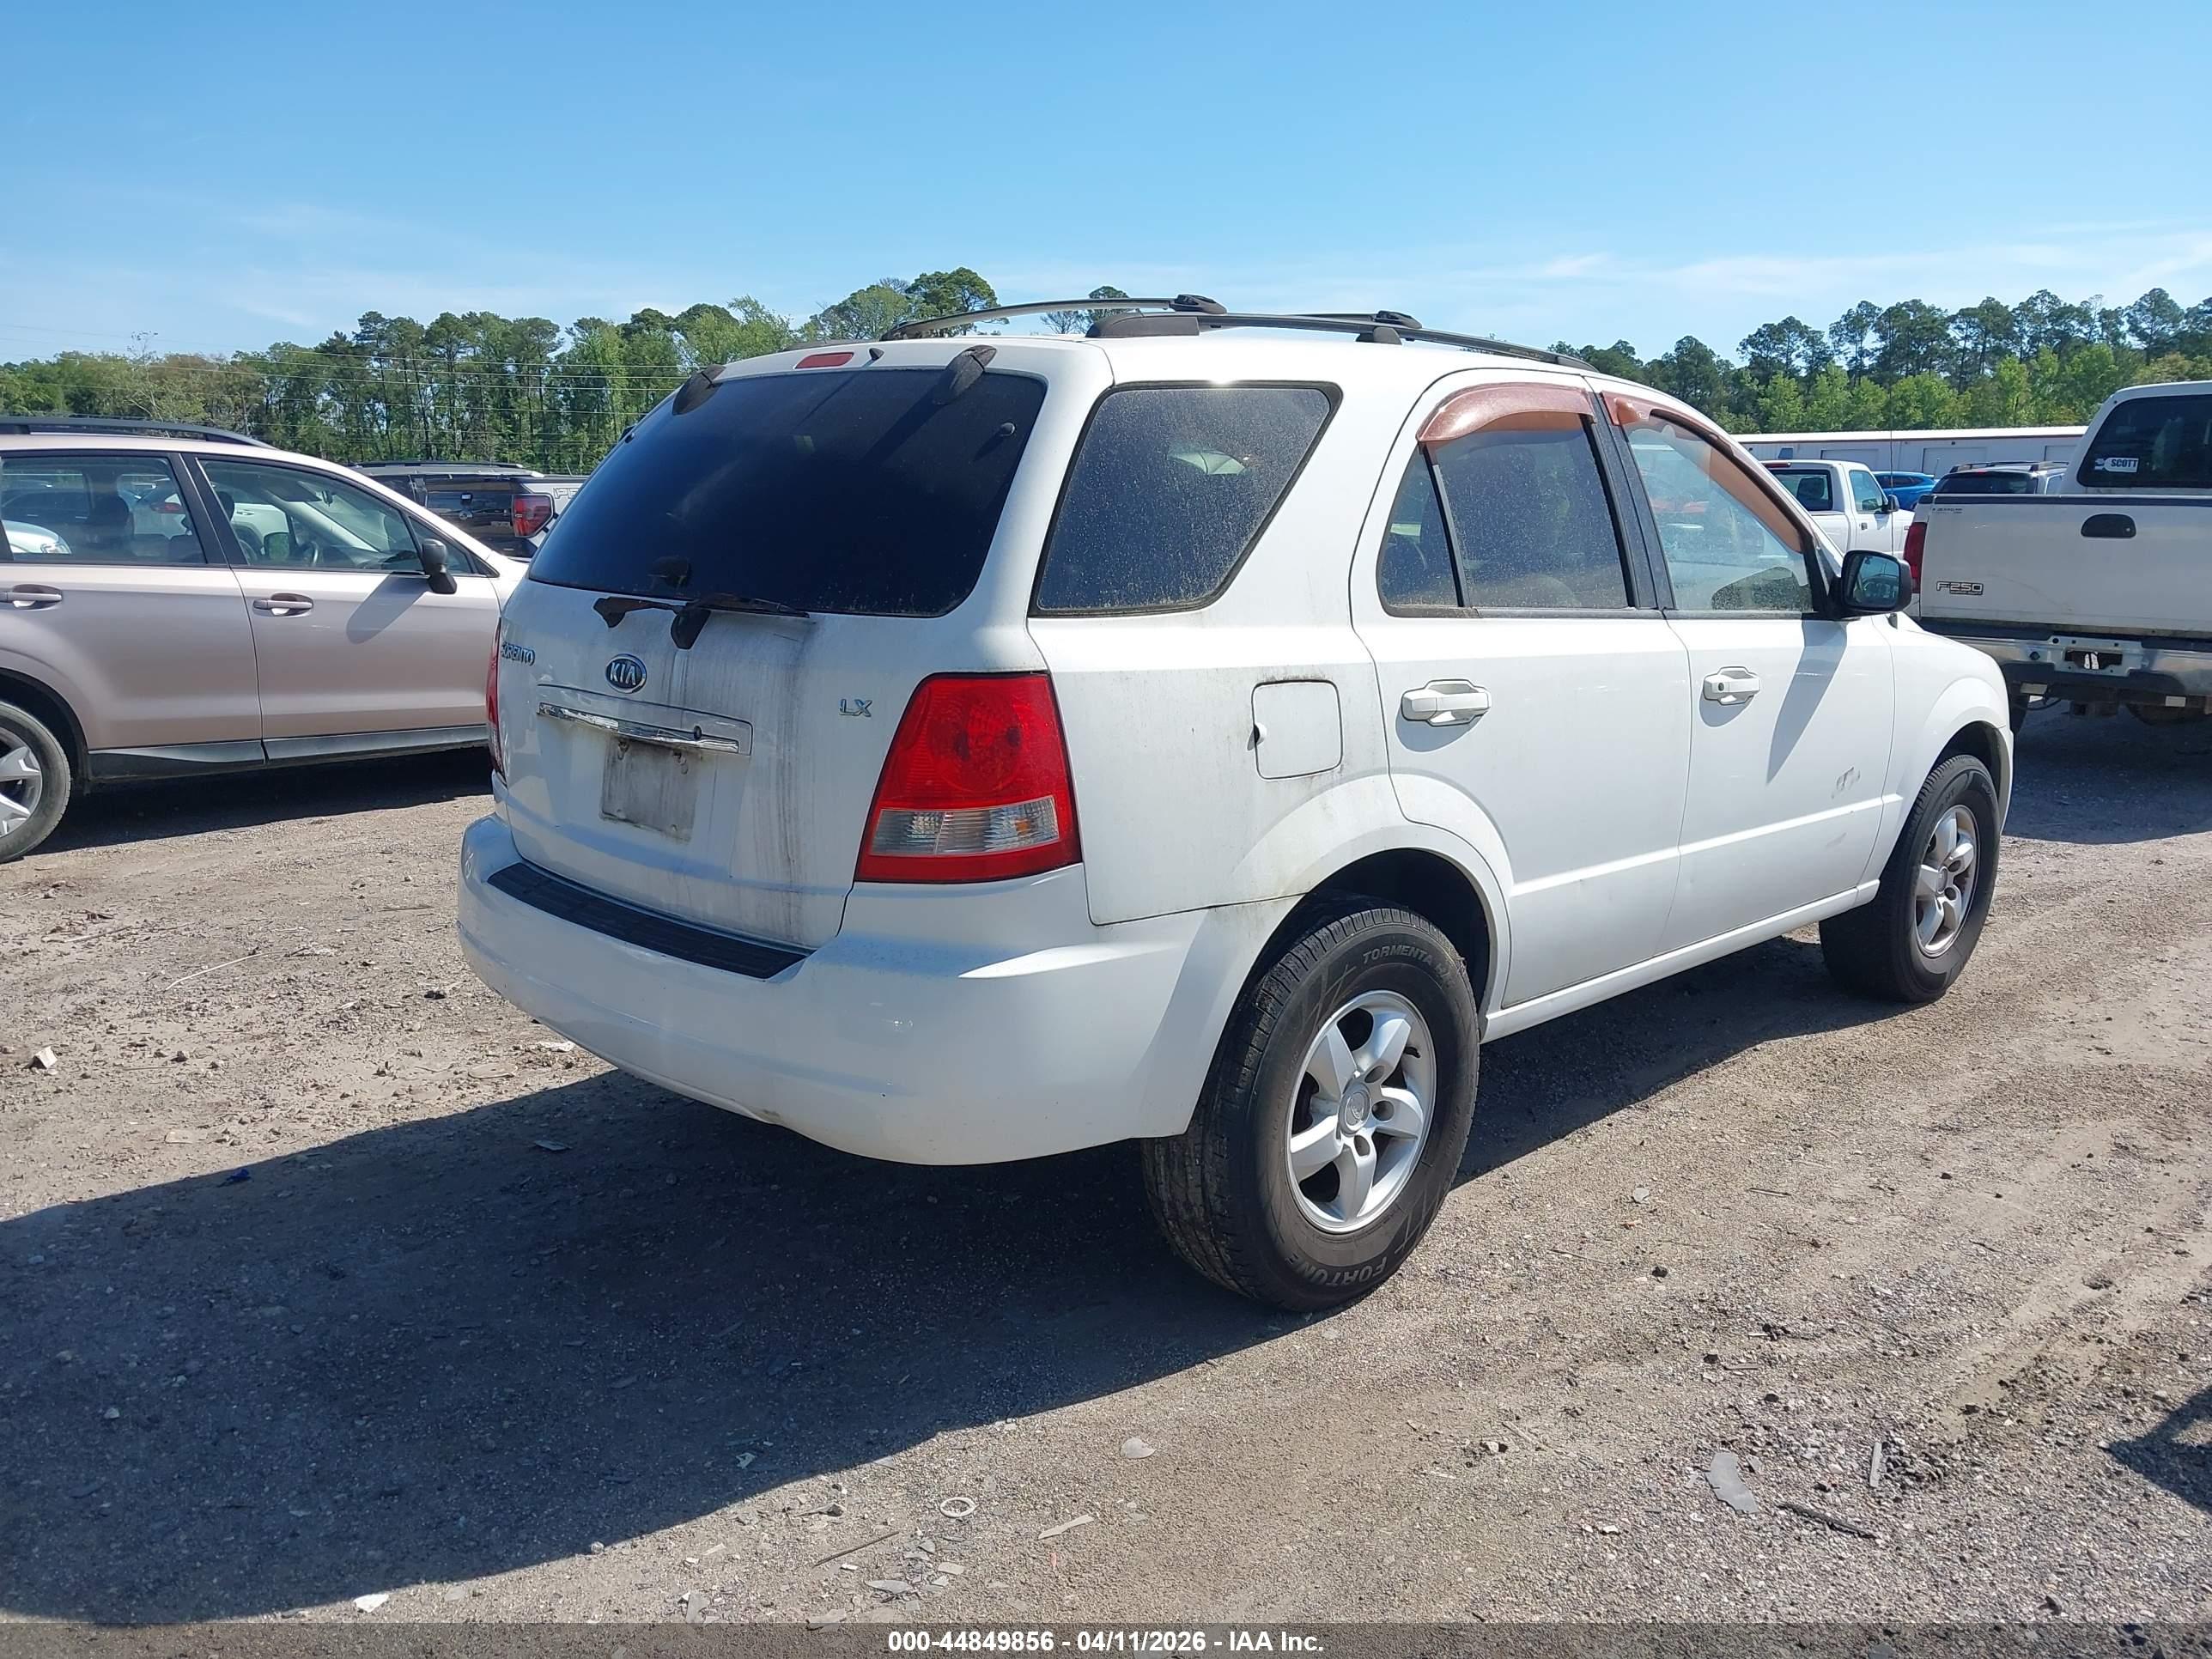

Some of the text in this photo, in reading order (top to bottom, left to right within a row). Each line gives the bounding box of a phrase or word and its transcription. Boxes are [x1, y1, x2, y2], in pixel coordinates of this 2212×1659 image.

[2111, 459, 2137, 468] SCOTT
[610, 661, 636, 685] KIA
[839, 698, 872, 717] LX
[1363, 945, 1434, 966] TORMENTA
